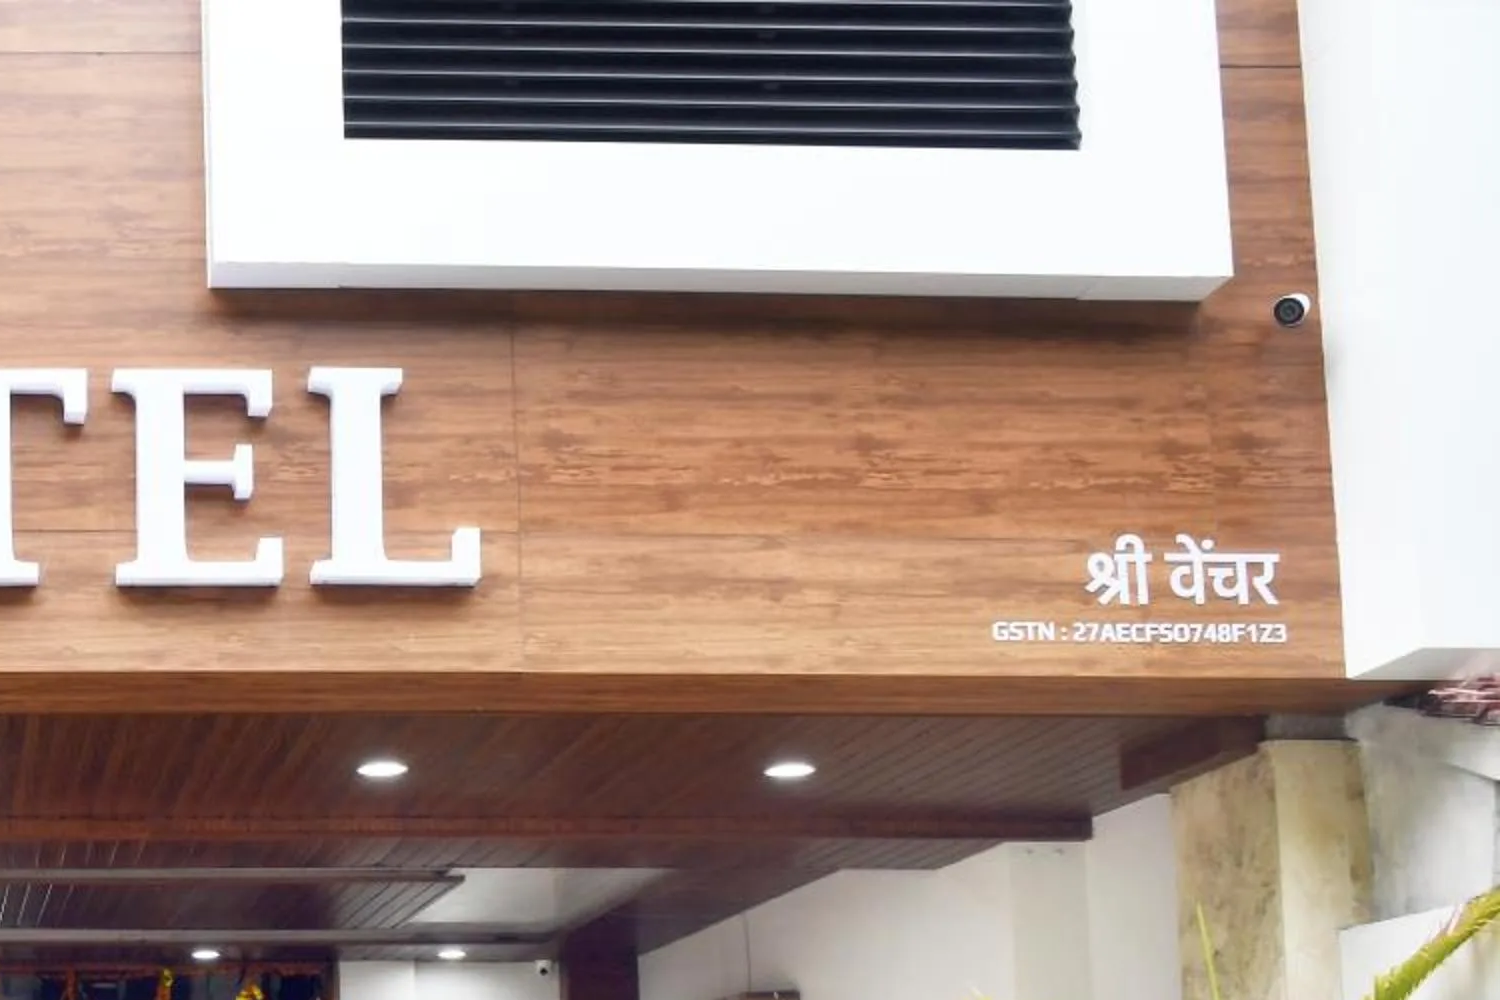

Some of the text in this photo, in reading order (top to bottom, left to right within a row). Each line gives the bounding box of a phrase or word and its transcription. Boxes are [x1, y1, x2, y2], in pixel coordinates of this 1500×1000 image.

[1084, 532, 1281, 605] श्री वेंचर
[991, 620, 1056, 642] GSTN
